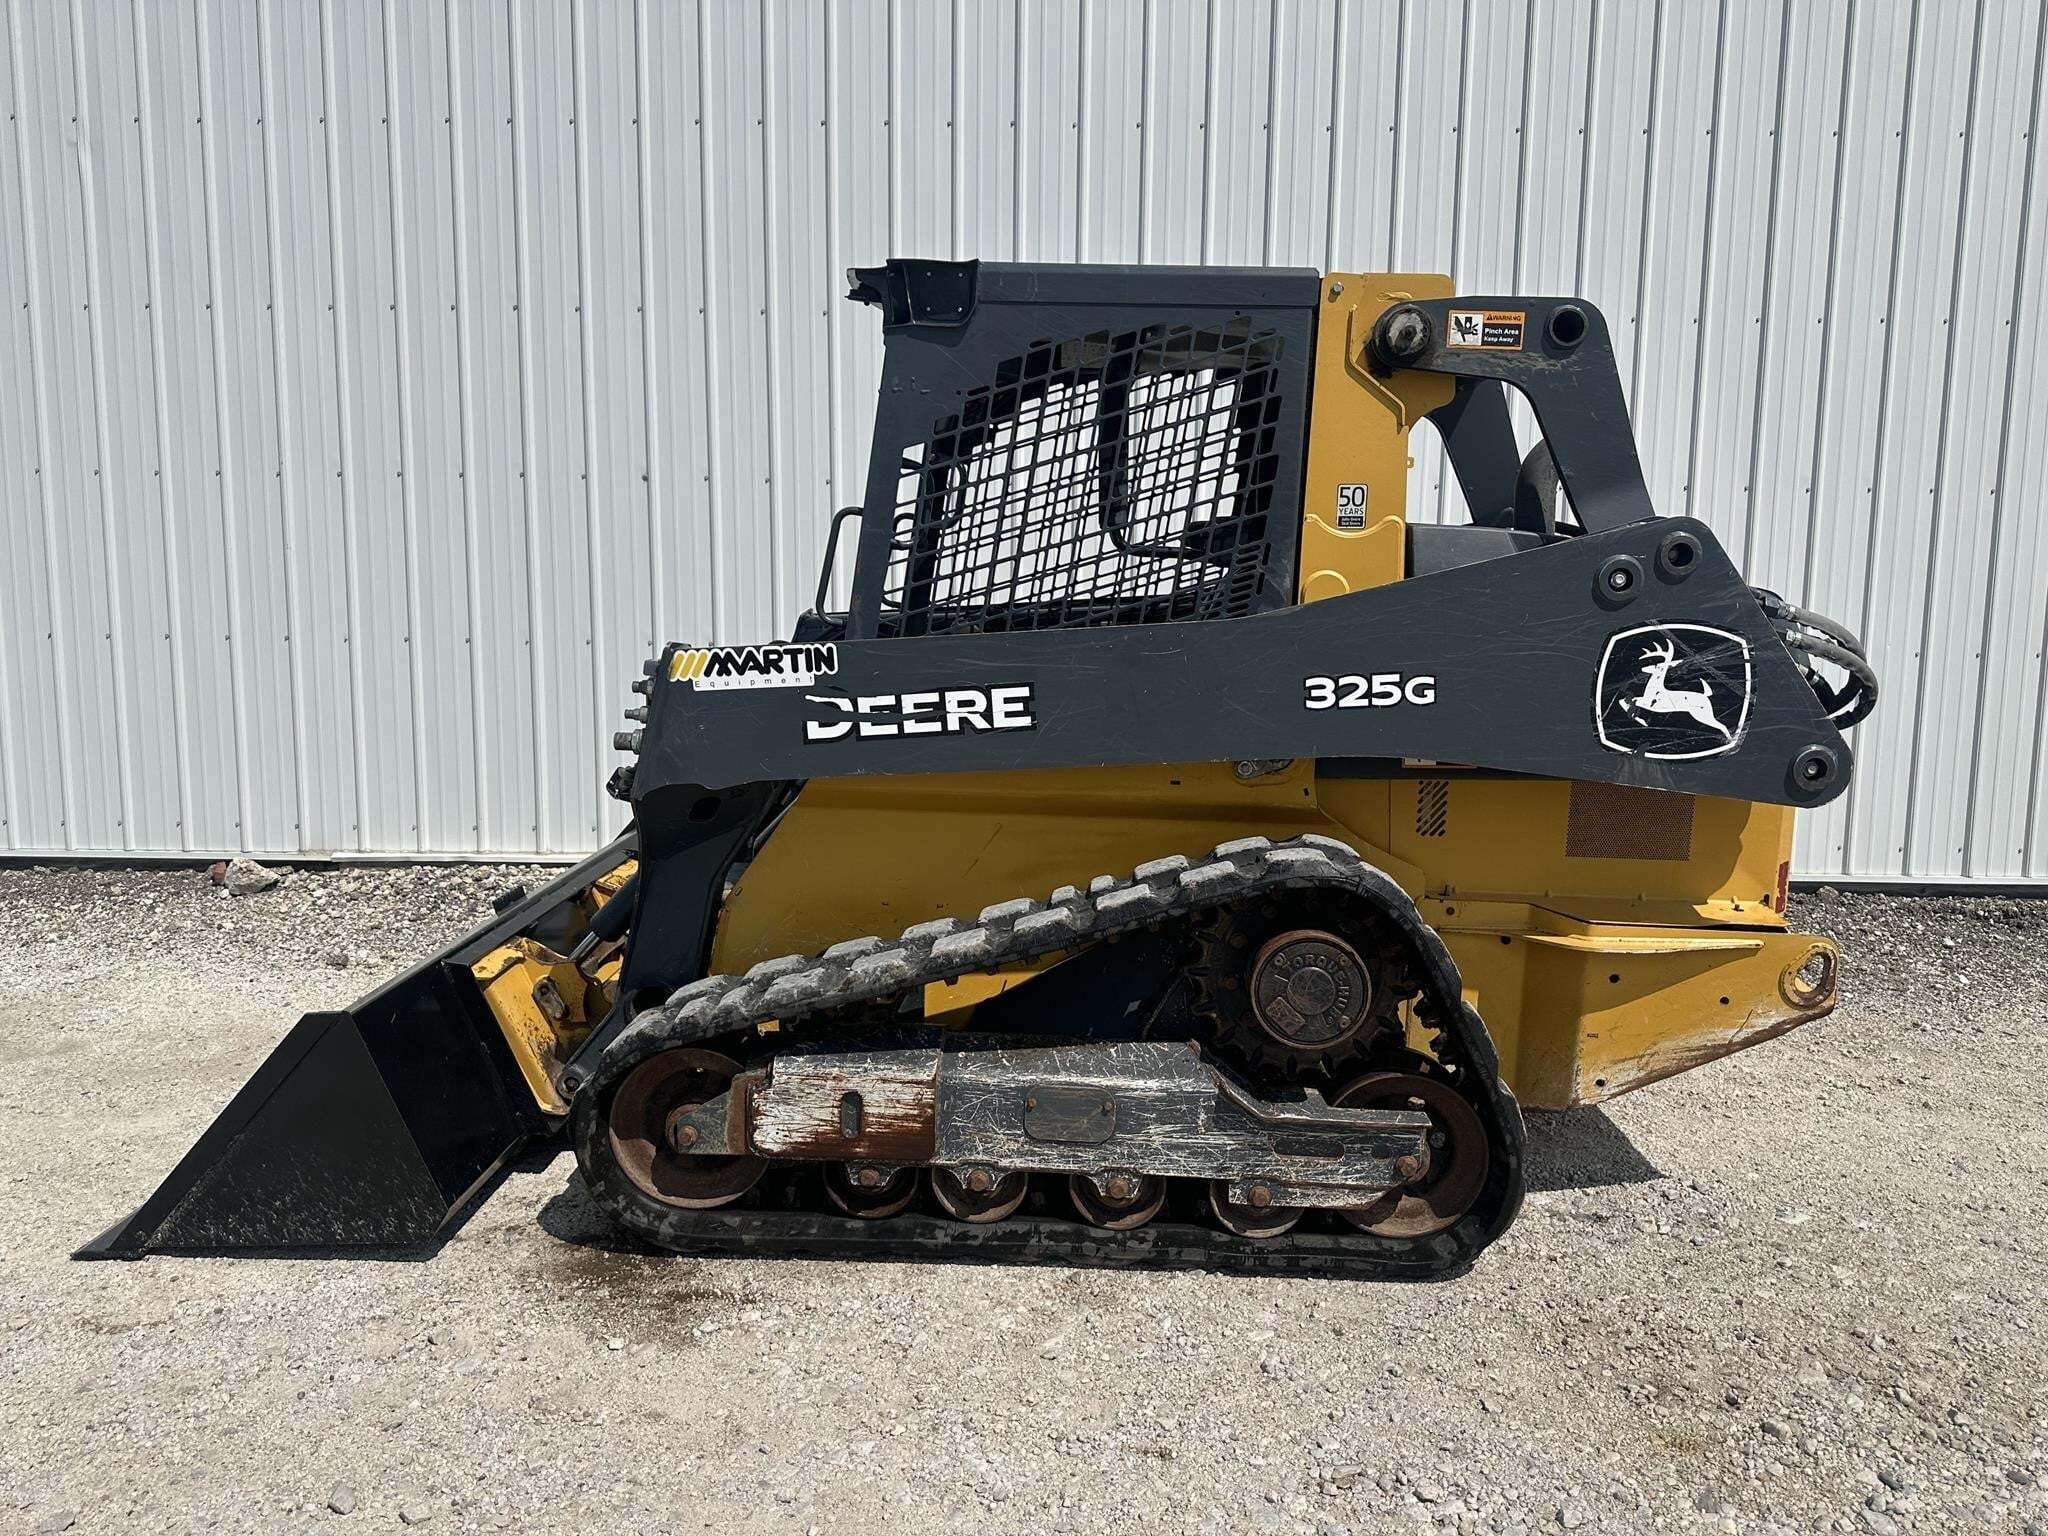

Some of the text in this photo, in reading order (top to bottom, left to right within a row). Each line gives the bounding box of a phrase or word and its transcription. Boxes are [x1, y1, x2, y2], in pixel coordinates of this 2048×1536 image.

[1339, 486, 1365, 507] 50
[1339, 507, 1364, 515] YEARS
[703, 645, 836, 678] MARTIN
[694, 676, 813, 688] Equipment
[1305, 673, 1435, 709] 325G
[805, 686, 1032, 740] DEERE
